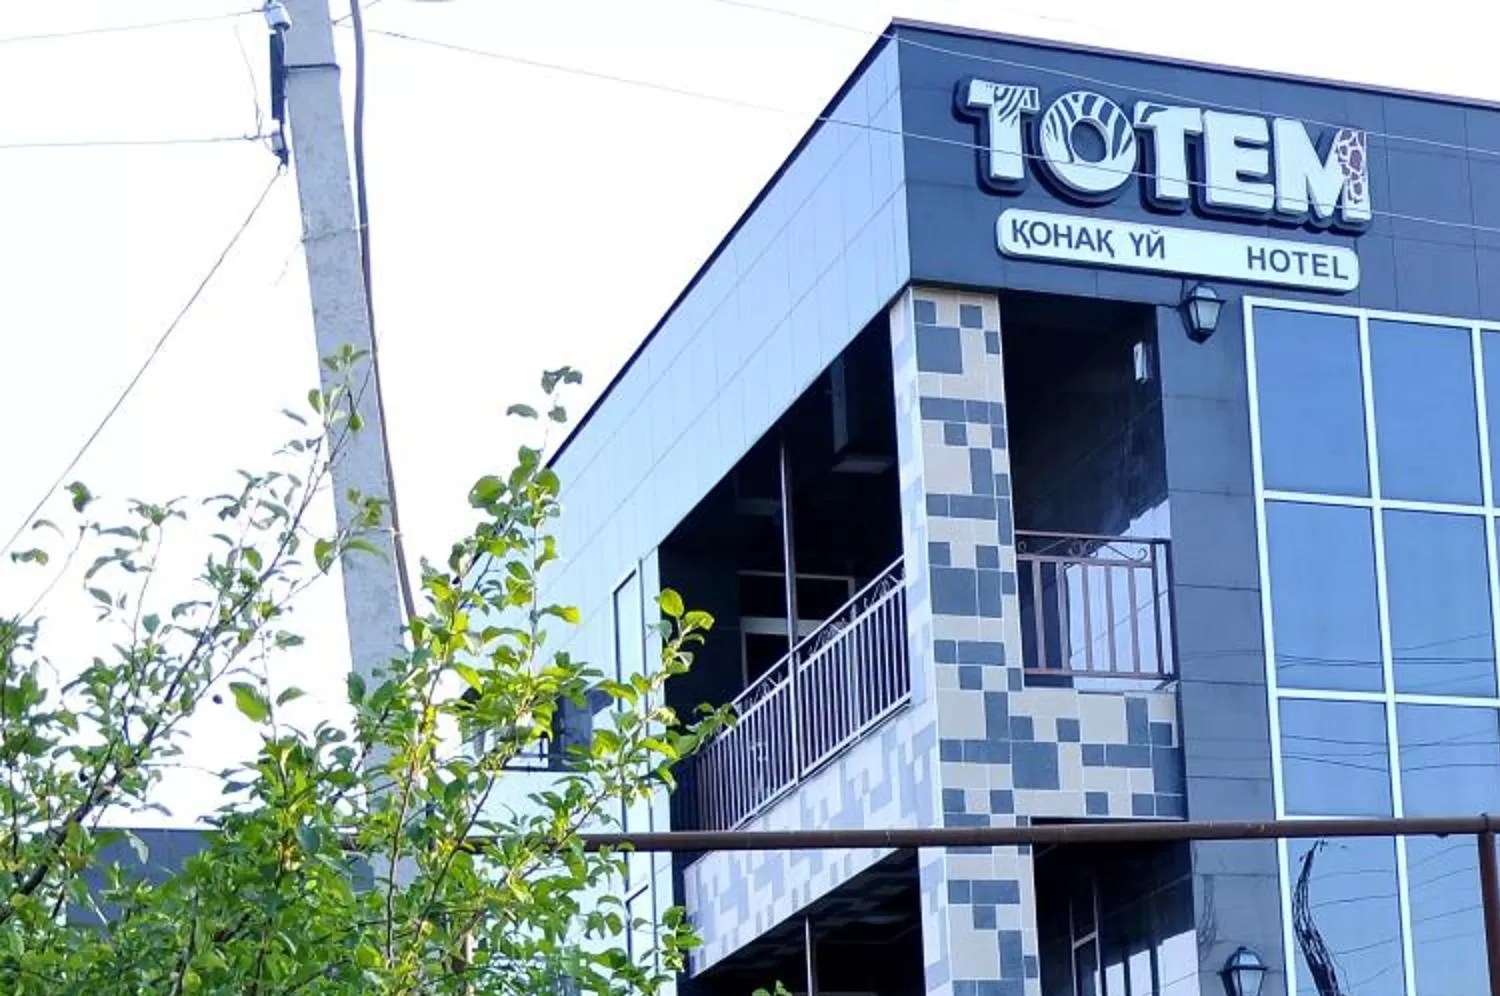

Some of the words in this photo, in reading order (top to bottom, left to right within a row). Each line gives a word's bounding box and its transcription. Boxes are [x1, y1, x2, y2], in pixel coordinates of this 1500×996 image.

[966, 79, 1372, 222] TOTEM
[1011, 218, 1115, 259] ҚОНАҚ
[1128, 229, 1166, 259] ҮЙ
[1247, 246, 1349, 280] HOTEL
